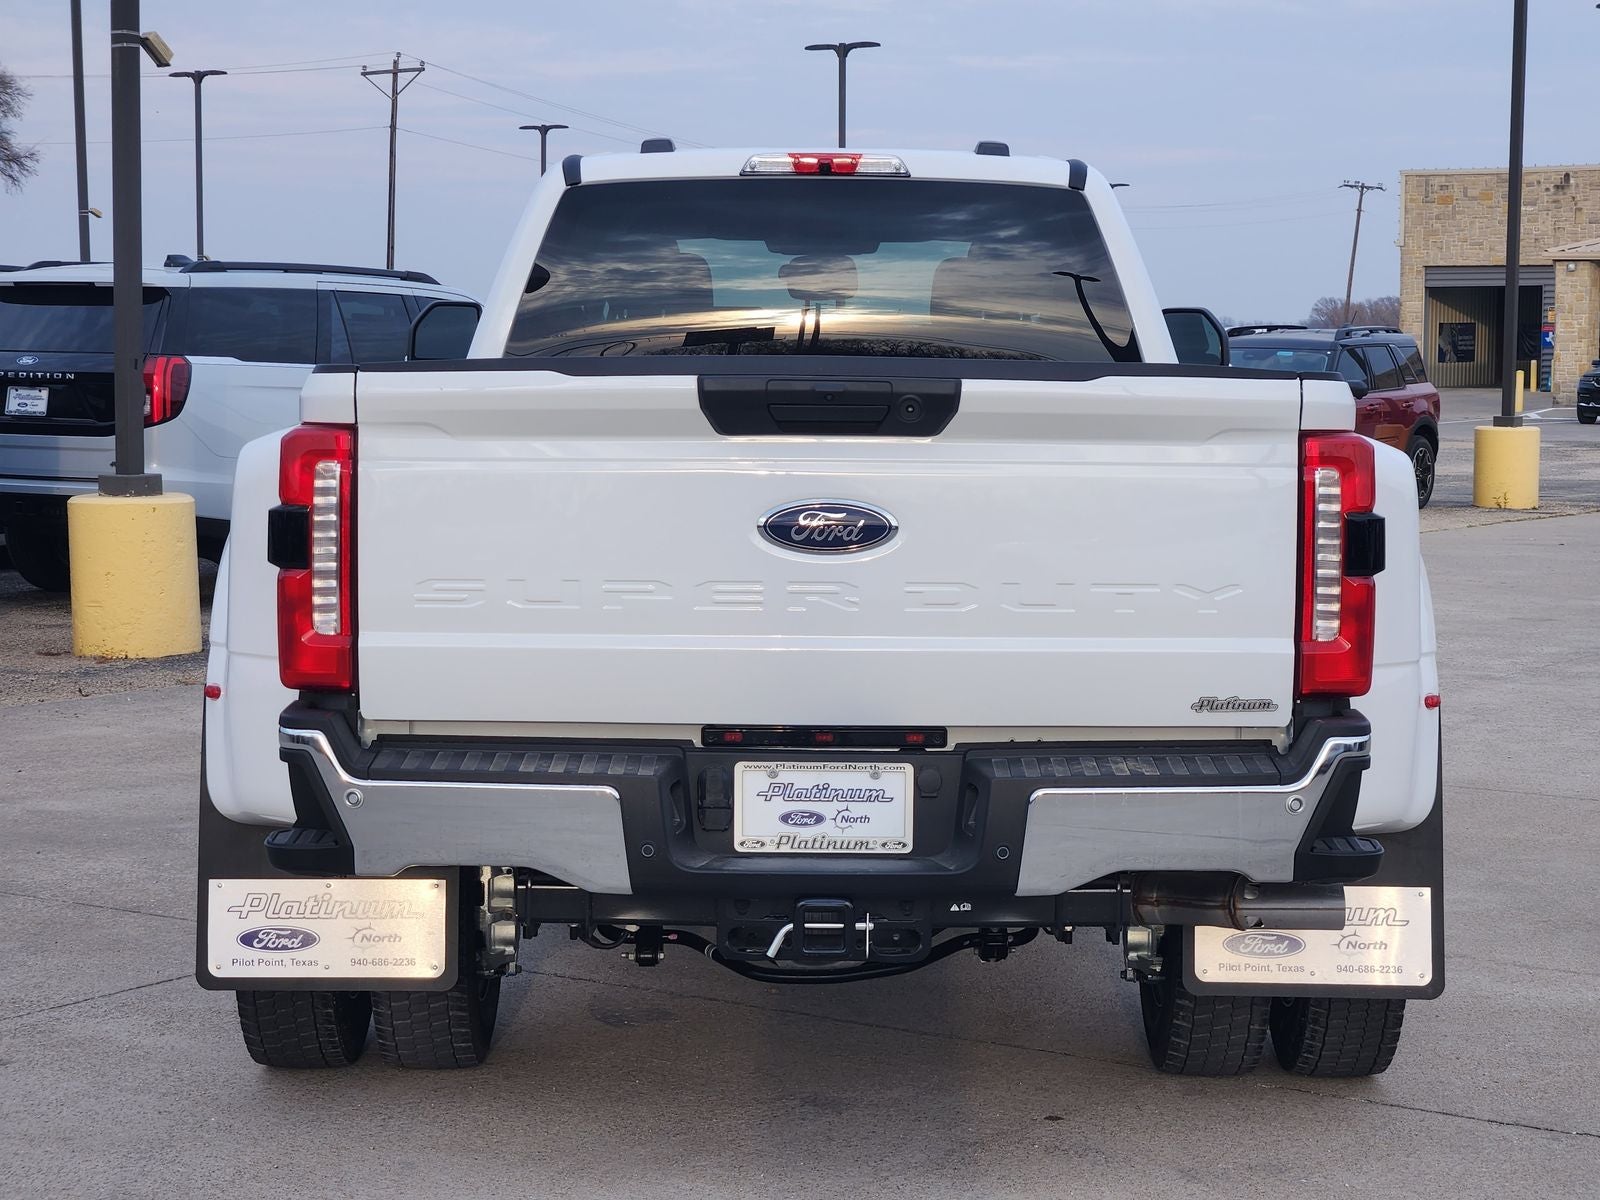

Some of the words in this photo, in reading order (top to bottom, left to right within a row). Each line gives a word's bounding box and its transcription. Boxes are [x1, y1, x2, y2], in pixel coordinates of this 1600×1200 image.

[790, 510, 865, 541] Ford
[413, 578, 859, 613] SUPER
[904, 580, 1243, 614] DUTY
[1191, 696, 1278, 713] Platinum
[743, 763, 906, 771] www.PlatinumFordNorth.com
[757, 782, 894, 803] Platinum
[840, 814, 871, 824] North
[776, 835, 875, 850] Platinum
[227, 892, 424, 920] Platinum
[252, 928, 303, 949] Ford
[360, 933, 402, 943] North
[1345, 939, 1388, 950] North
[1239, 935, 1290, 955] Ford
[231, 958, 255, 967] Pilot
[257, 958, 287, 968] Point,
[290, 958, 319, 967] Texas
[350, 957, 416, 967] 940-686-2236
[1218, 963, 1242, 973] Pilot
[1244, 963, 1273, 974] Point,
[1276, 963, 1305, 973] Texas
[1336, 964, 1403, 974] 940-686-2236
